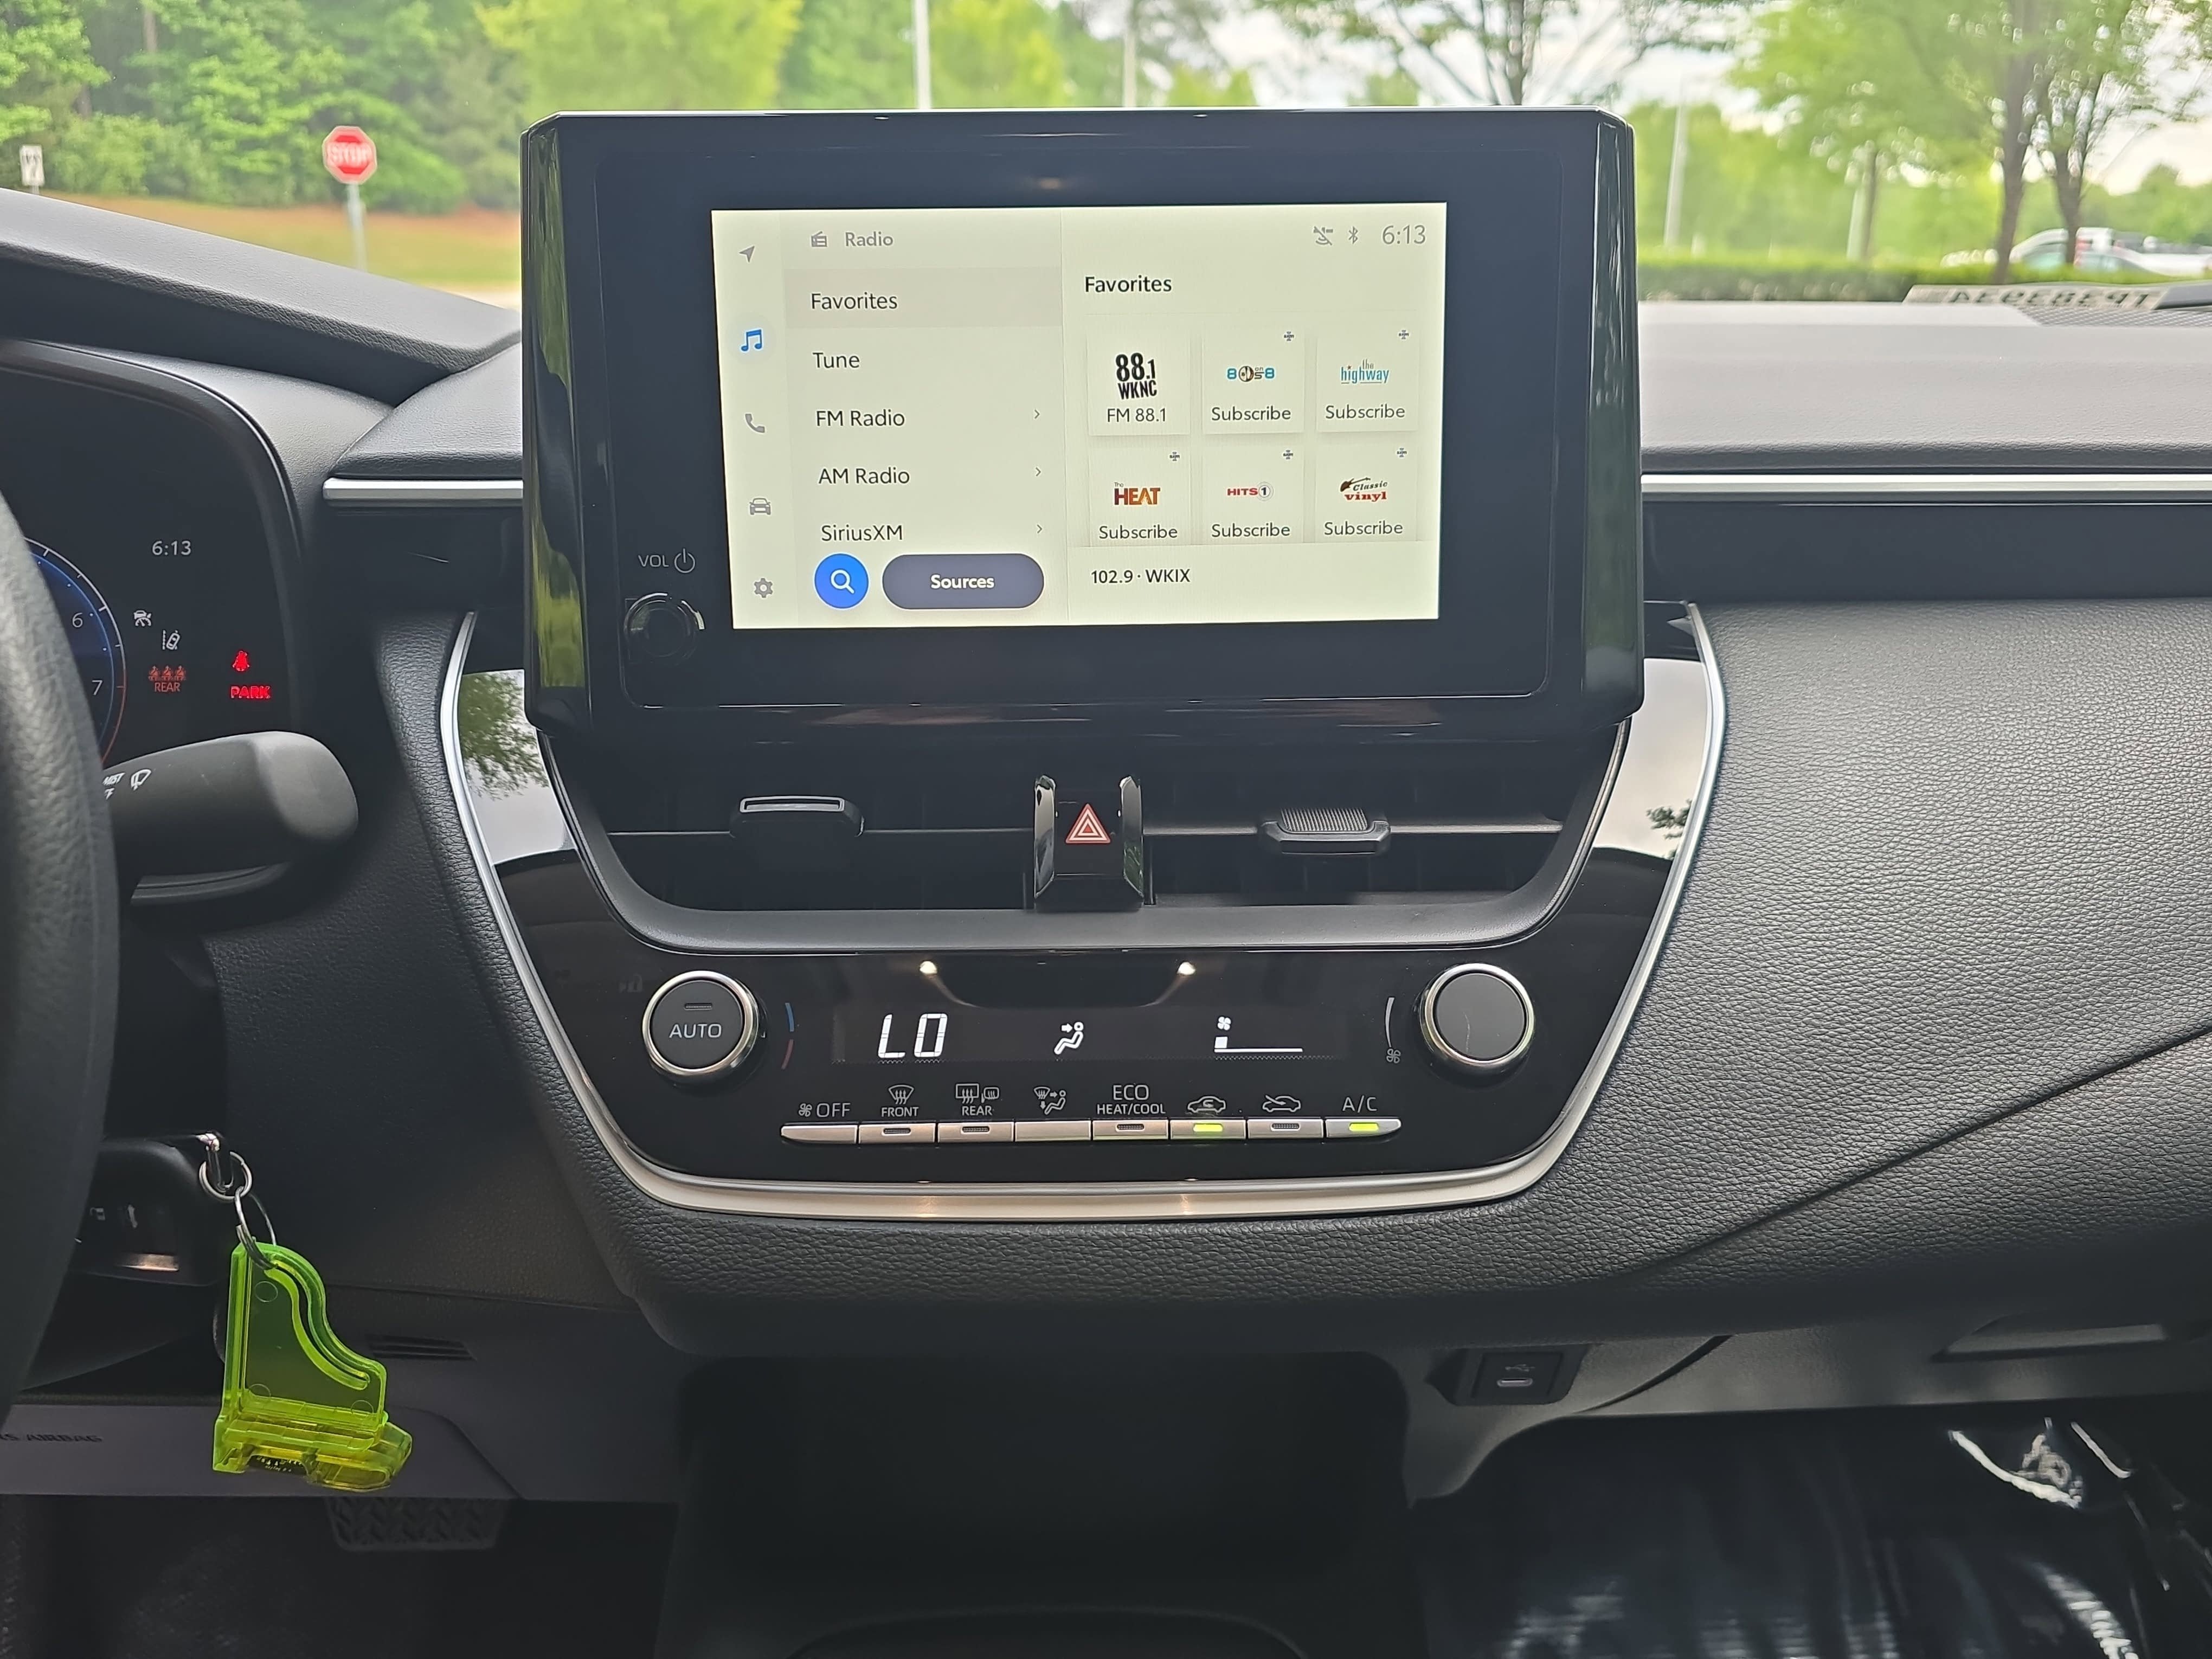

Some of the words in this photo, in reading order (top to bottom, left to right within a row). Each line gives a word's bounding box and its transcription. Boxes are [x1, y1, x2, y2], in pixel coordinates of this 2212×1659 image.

[327, 143, 372, 164] STOP
[845, 232, 893, 247] Radio
[1382, 225, 1425, 245] 6:13
[1085, 275, 1172, 293] Favorites
[812, 292, 897, 310] Favorites
[813, 352, 860, 369] Tune
[1116, 353, 1156, 382] 88.1
[1341, 366, 1390, 384] highway
[1118, 379, 1157, 400] WKNC
[816, 410, 844, 426] FM
[851, 409, 905, 426] Radio
[1107, 408, 1130, 422] FM
[1135, 408, 1166, 422] 88.1
[1212, 406, 1291, 421] Subscribe
[1326, 403, 1405, 419] Subscribe
[819, 468, 848, 484] AM
[856, 467, 910, 484] Radio
[1353, 480, 1388, 491] Classic
[1114, 487, 1160, 505] HEAT
[1345, 491, 1387, 502] vinyl
[821, 524, 902, 542] SiriusXM
[1099, 524, 1178, 539] Subscribe
[1212, 522, 1290, 537] Subscribe
[1324, 520, 1403, 535] Subscribe
[152, 541, 191, 556] 6:13
[638, 555, 670, 567] VOL
[930, 574, 994, 589] Sources
[1091, 570, 1133, 583] 102.9
[1145, 569, 1190, 583] WKIX
[72, 612, 83, 628] 6
[92, 680, 103, 696] 7
[154, 681, 181, 693] REAR
[231, 685, 271, 699] PARK
[669, 1024, 722, 1038] AUTO
[878, 1013, 948, 1058] LO
[1113, 1084, 1149, 1101] ECO
[816, 1103, 851, 1117] OFF
[962, 1105, 994, 1116] REAR
[1097, 1103, 1166, 1115] HEAT/COOL
[1342, 1095, 1378, 1113] A/C
[882, 1107, 919, 1117] FRONT
